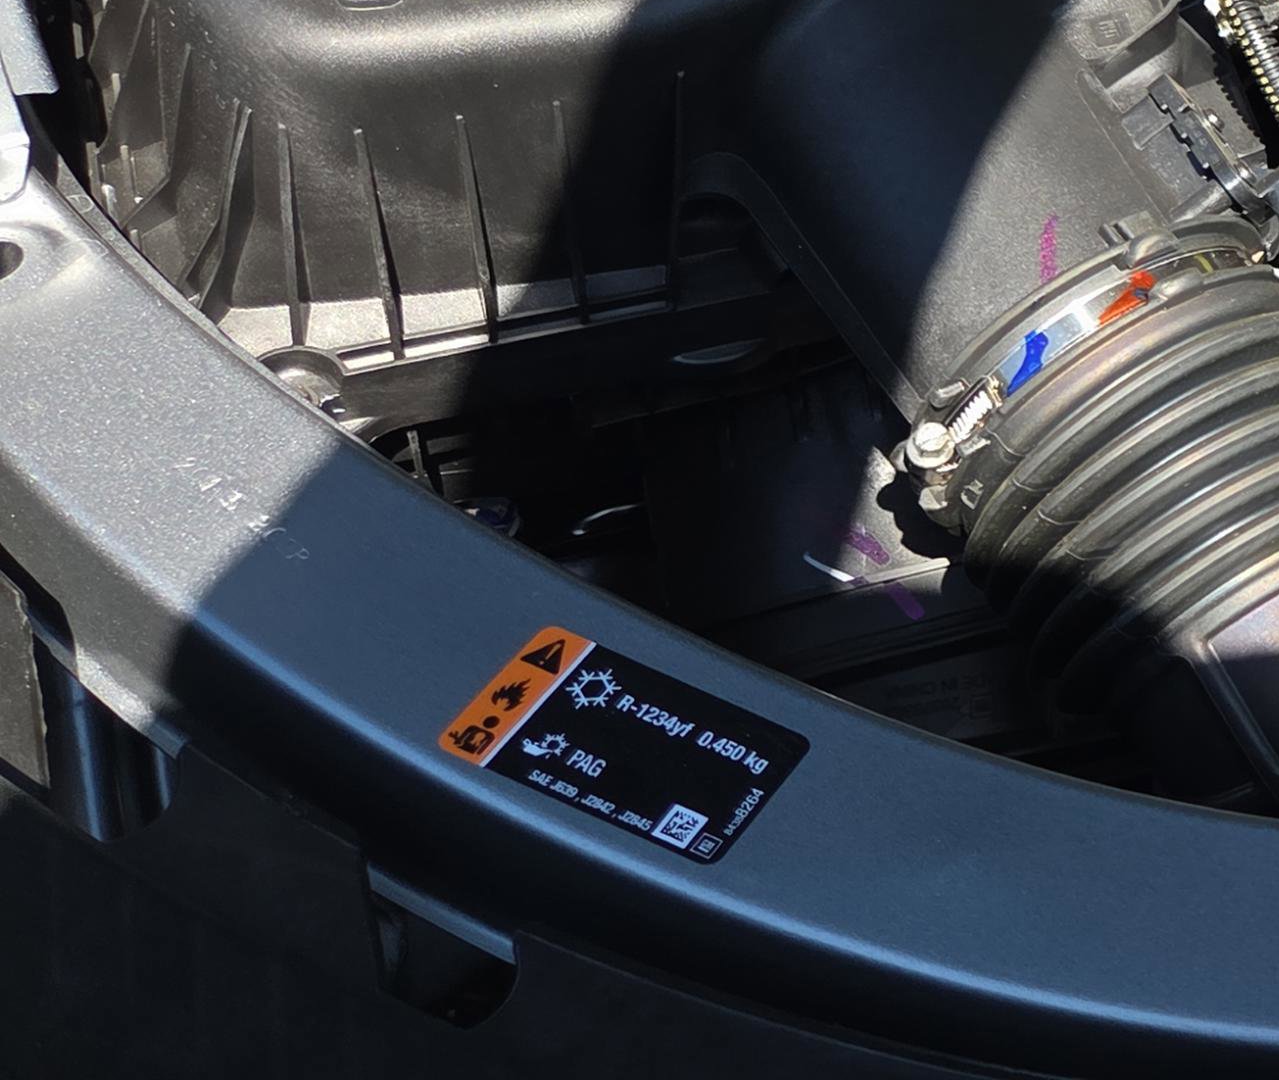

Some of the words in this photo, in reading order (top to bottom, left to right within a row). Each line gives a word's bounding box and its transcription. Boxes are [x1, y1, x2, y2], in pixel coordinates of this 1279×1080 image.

[614, 693, 695, 738] R-1234yf
[696, 729, 744, 764] 0.450
[743, 749, 770, 776] kg
[527, 768, 552, 790] SAE
[566, 747, 608, 779] PAG
